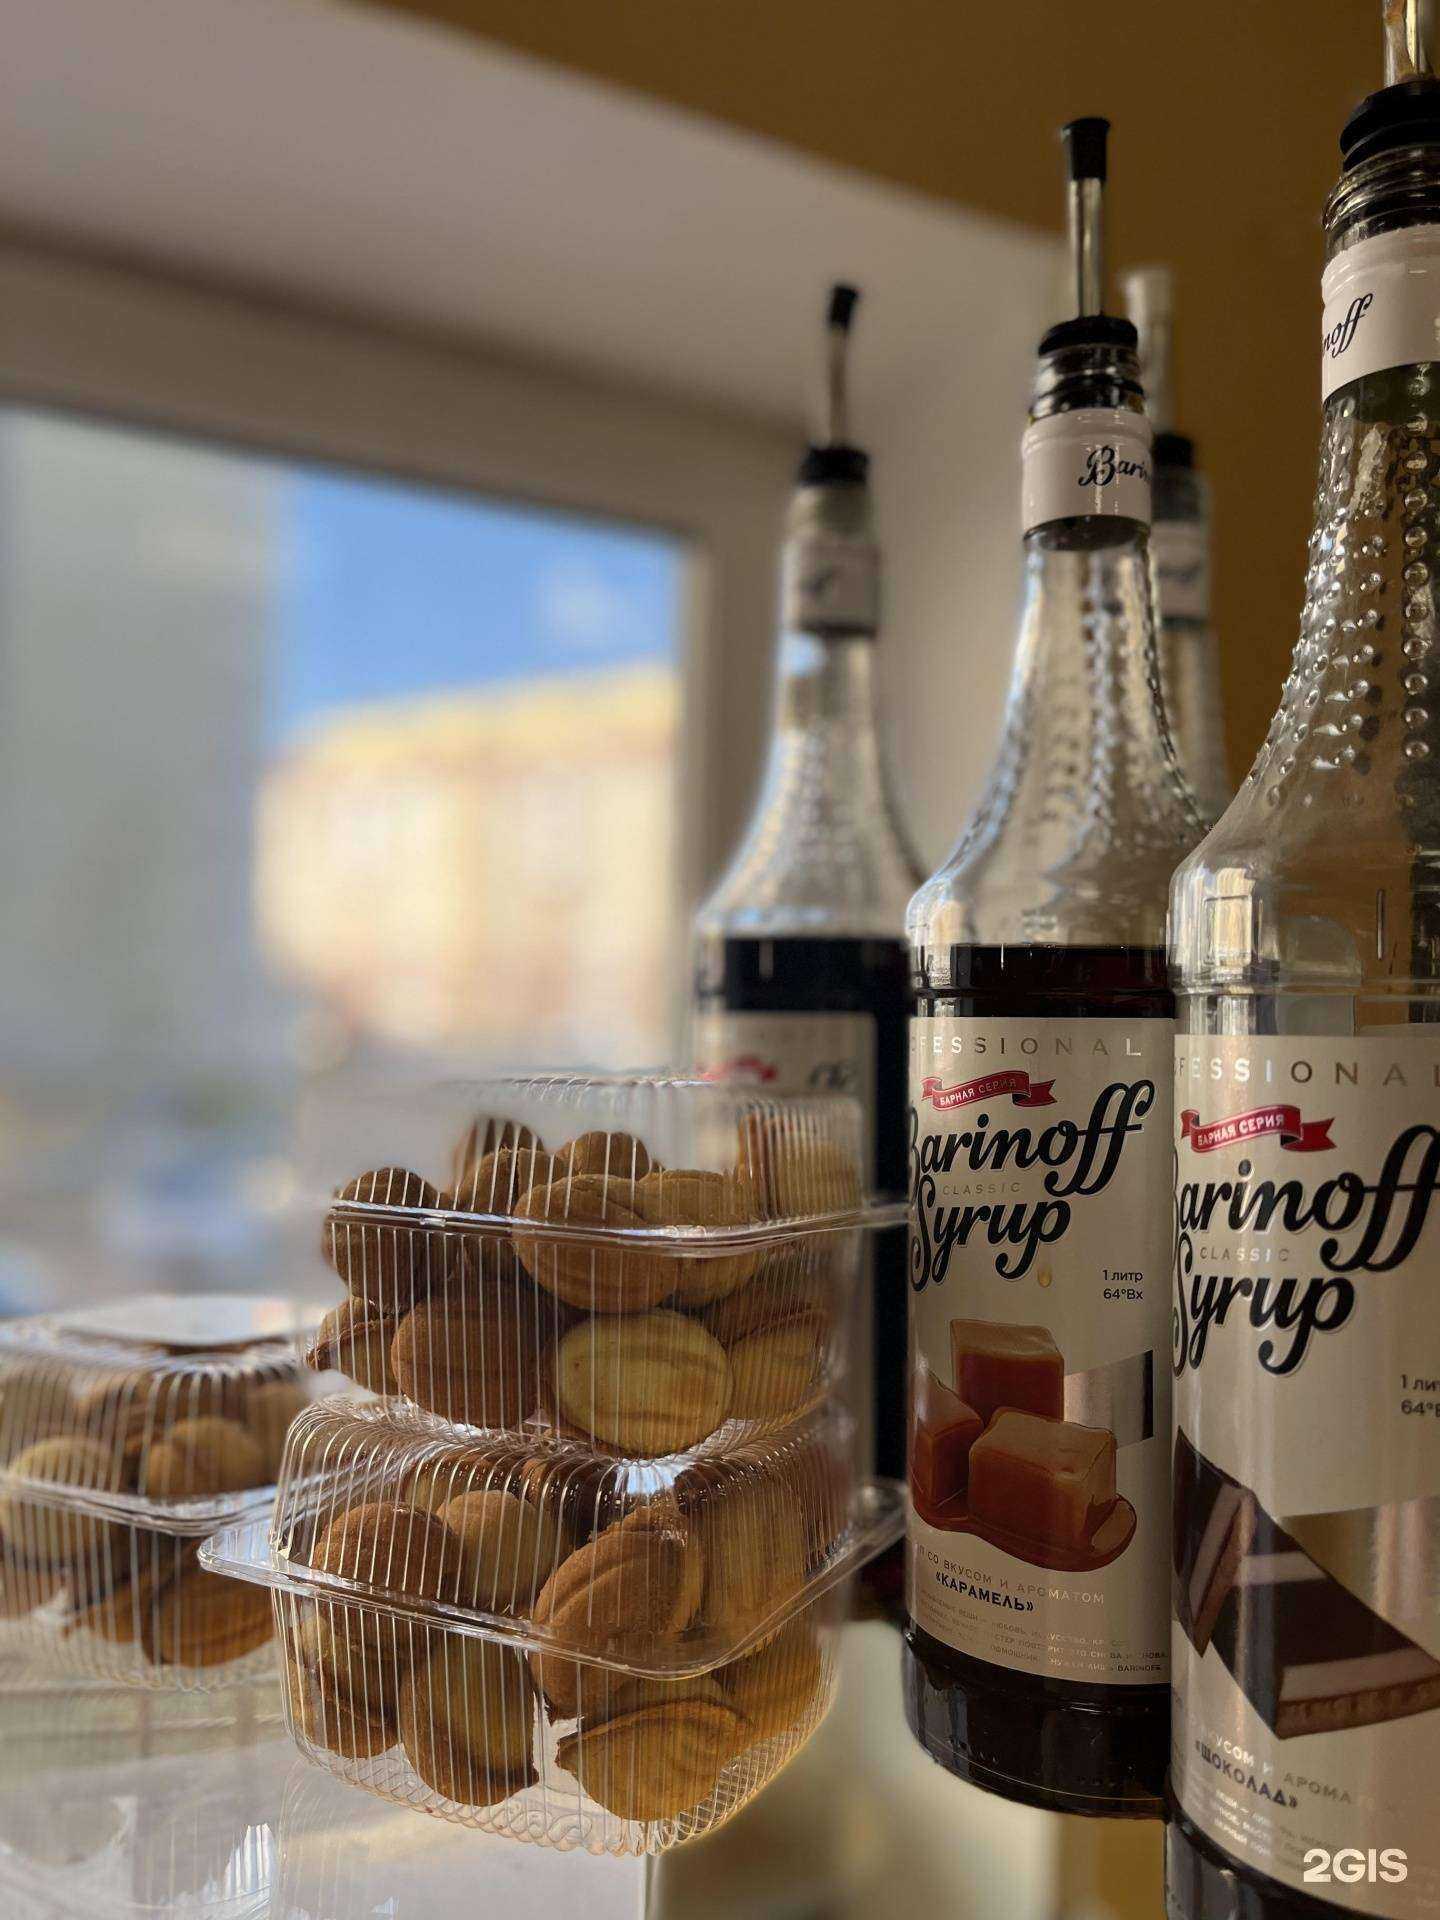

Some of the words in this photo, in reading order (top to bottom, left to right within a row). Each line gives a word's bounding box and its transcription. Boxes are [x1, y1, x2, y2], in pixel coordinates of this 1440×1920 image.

[1324, 293, 1373, 358] noff
[1078, 445, 1149, 486] Bari
[912, 1037, 1142, 1056] FESSIONAL
[1174, 1057, 1440, 1088] FESSIONAL
[939, 1086, 976, 1106] БАРНАЯ
[978, 1077, 1017, 1095] СЕРИЯ
[1197, 1123, 1236, 1146] БАРНАЯ
[1238, 1113, 1285, 1135] СЕРИЯ
[942, 1182, 1022, 1196] CLASSIC
[1172, 1124, 1440, 1272] arinoff
[910, 1174, 1072, 1292] Syrup
[1200, 1246, 1289, 1262] CLASSIC
[1102, 1269, 1108, 1281] 1
[1111, 1271, 1143, 1283] литр
[1172, 1232, 1357, 1379] Syrup
[1401, 1374, 1407, 1389] 1
[944, 1559, 993, 1584] ВКУСОМ
[1000, 1579, 1009, 1590] И
[935, 1570, 1035, 1613] «КАРАМЕЛЬ»
